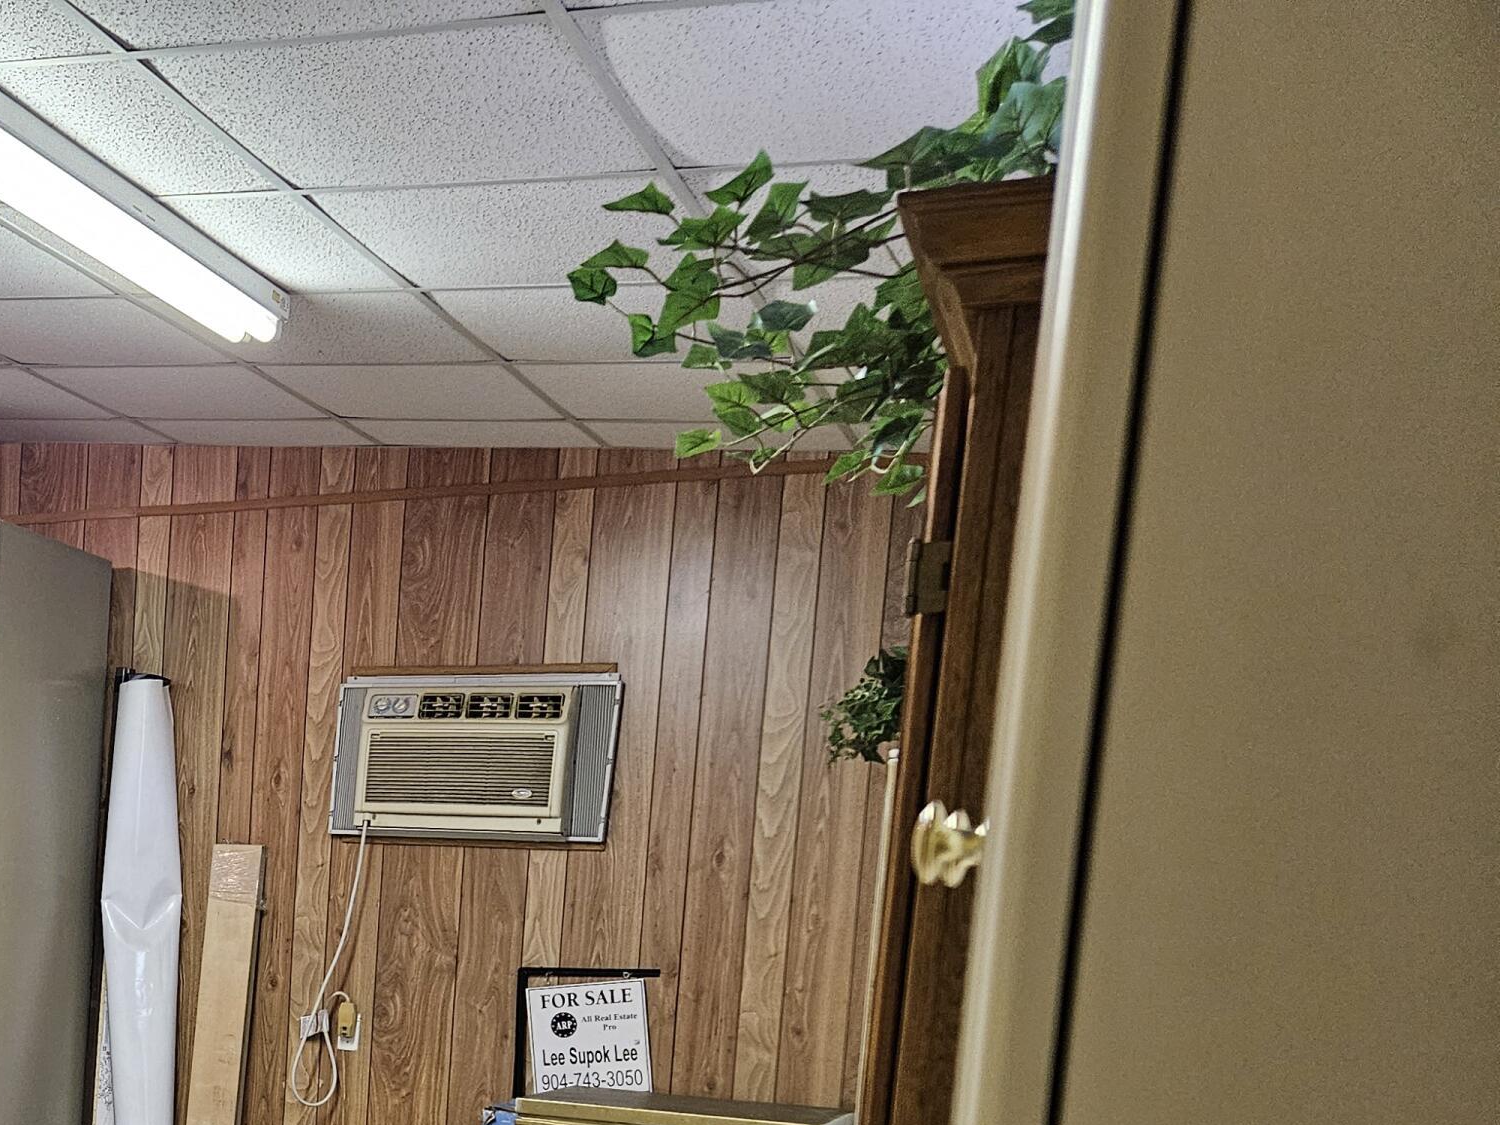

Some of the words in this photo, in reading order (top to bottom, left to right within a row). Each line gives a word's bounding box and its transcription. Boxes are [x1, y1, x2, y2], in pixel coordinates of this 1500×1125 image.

[540, 992, 579, 1009] FOR
[585, 988, 633, 1006] SALE
[556, 1020, 573, 1031] ARP
[581, 1015, 592, 1023] All
[594, 1014, 612, 1022] Real
[614, 1013, 638, 1021] Estate
[542, 1049, 565, 1066] Lee
[569, 1045, 611, 1068] Supok
[614, 1044, 638, 1062] Lee
[541, 1069, 643, 1091] 904-743-3050
